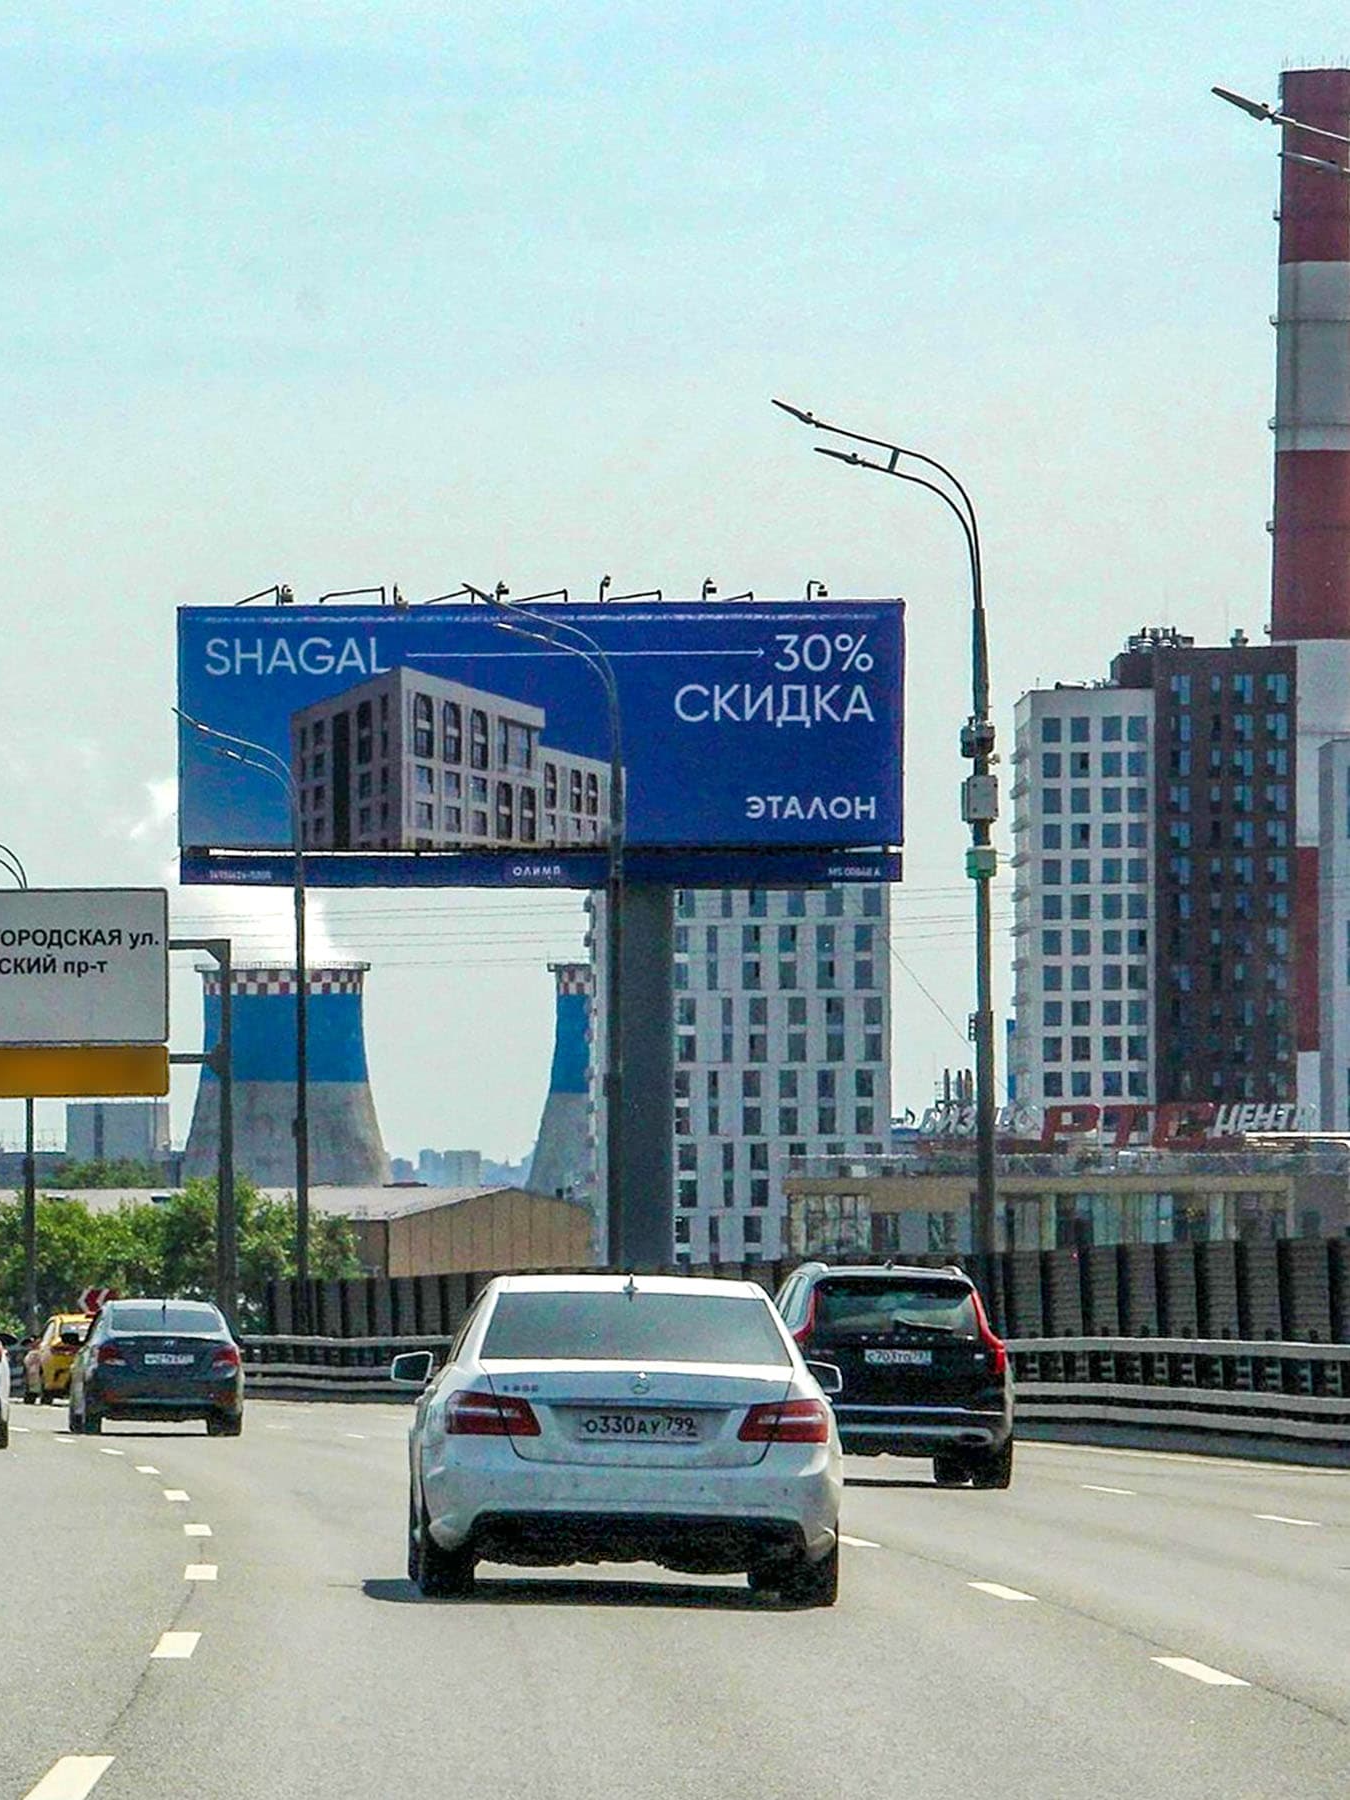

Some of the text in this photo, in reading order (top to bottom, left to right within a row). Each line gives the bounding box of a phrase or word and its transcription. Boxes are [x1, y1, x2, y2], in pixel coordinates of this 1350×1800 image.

[204, 636, 391, 677] SHAGAL
[774, 632, 875, 674] 30%
[673, 682, 875, 728] СКИДКА
[745, 795, 876, 821] ЭТАЛОН
[128, 934, 160, 949] ул.
[63, 960, 108, 977] пр-т
